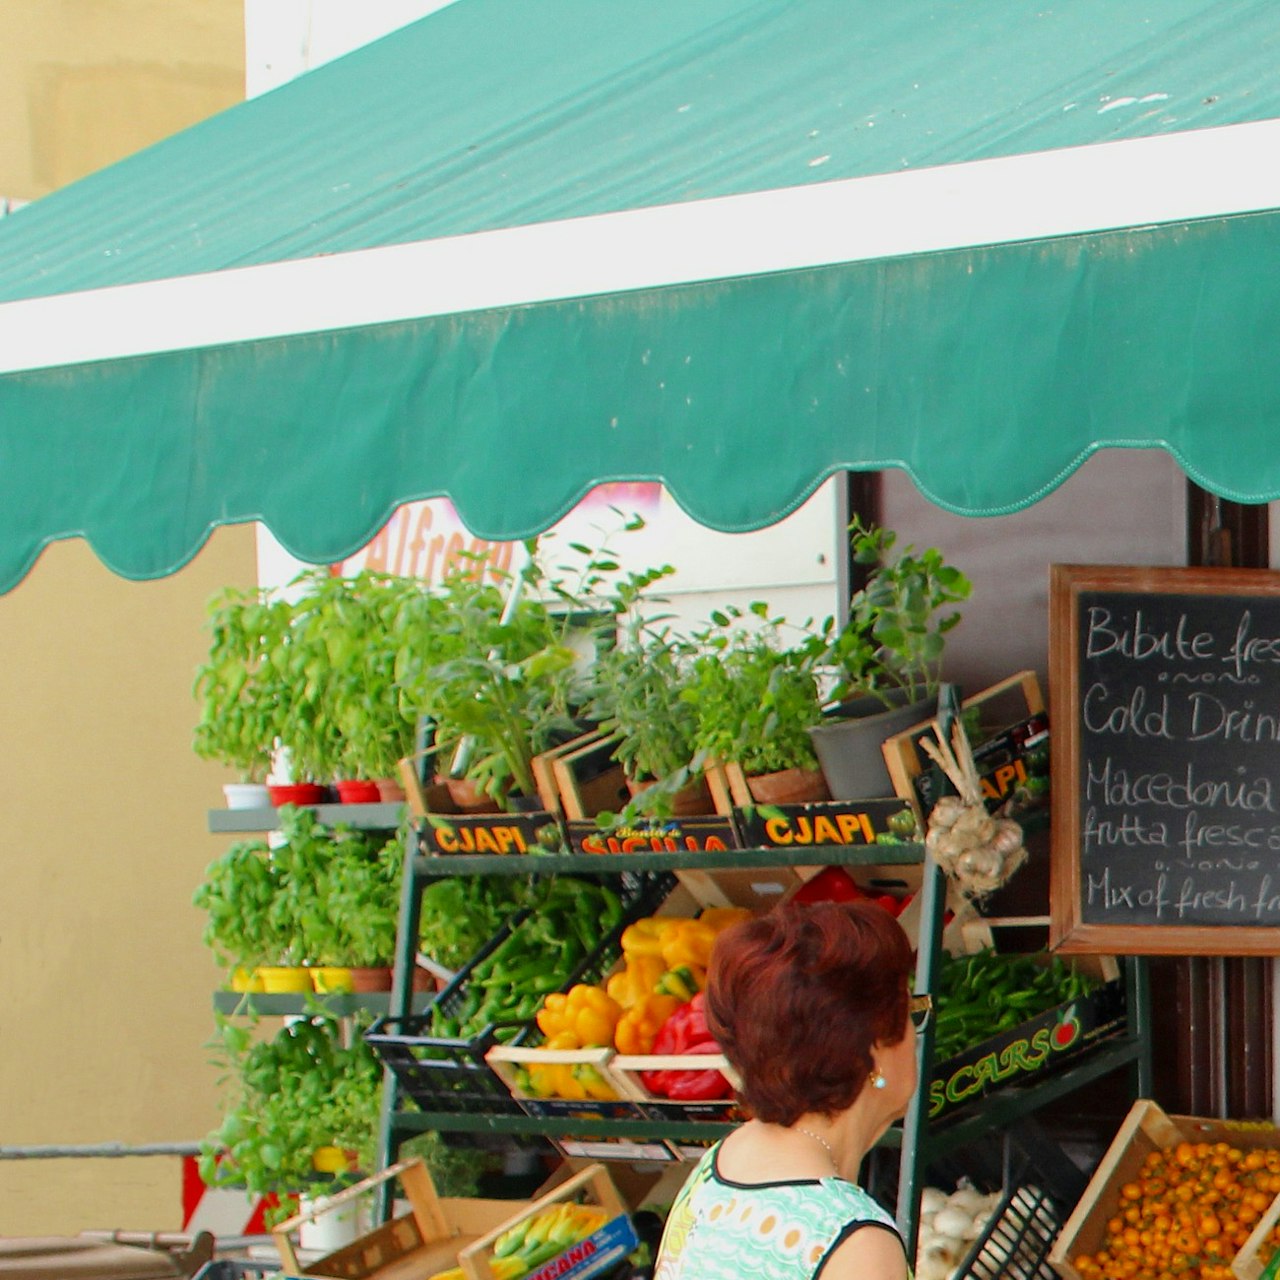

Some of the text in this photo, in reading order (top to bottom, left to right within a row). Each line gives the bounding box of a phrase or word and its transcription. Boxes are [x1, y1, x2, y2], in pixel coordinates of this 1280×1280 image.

[1086, 606, 1214, 661] Bibite
[1083, 683, 1172, 741] Cold
[1086, 756, 1273, 810] Macedonia
[434, 825, 530, 855] CJAPI
[764, 812, 876, 848] CJAPI
[1083, 805, 1167, 853] frutta
[1087, 867, 1134, 910] Mix
[1138, 869, 1168, 918] of
[1173, 877, 1248, 919] fresh
